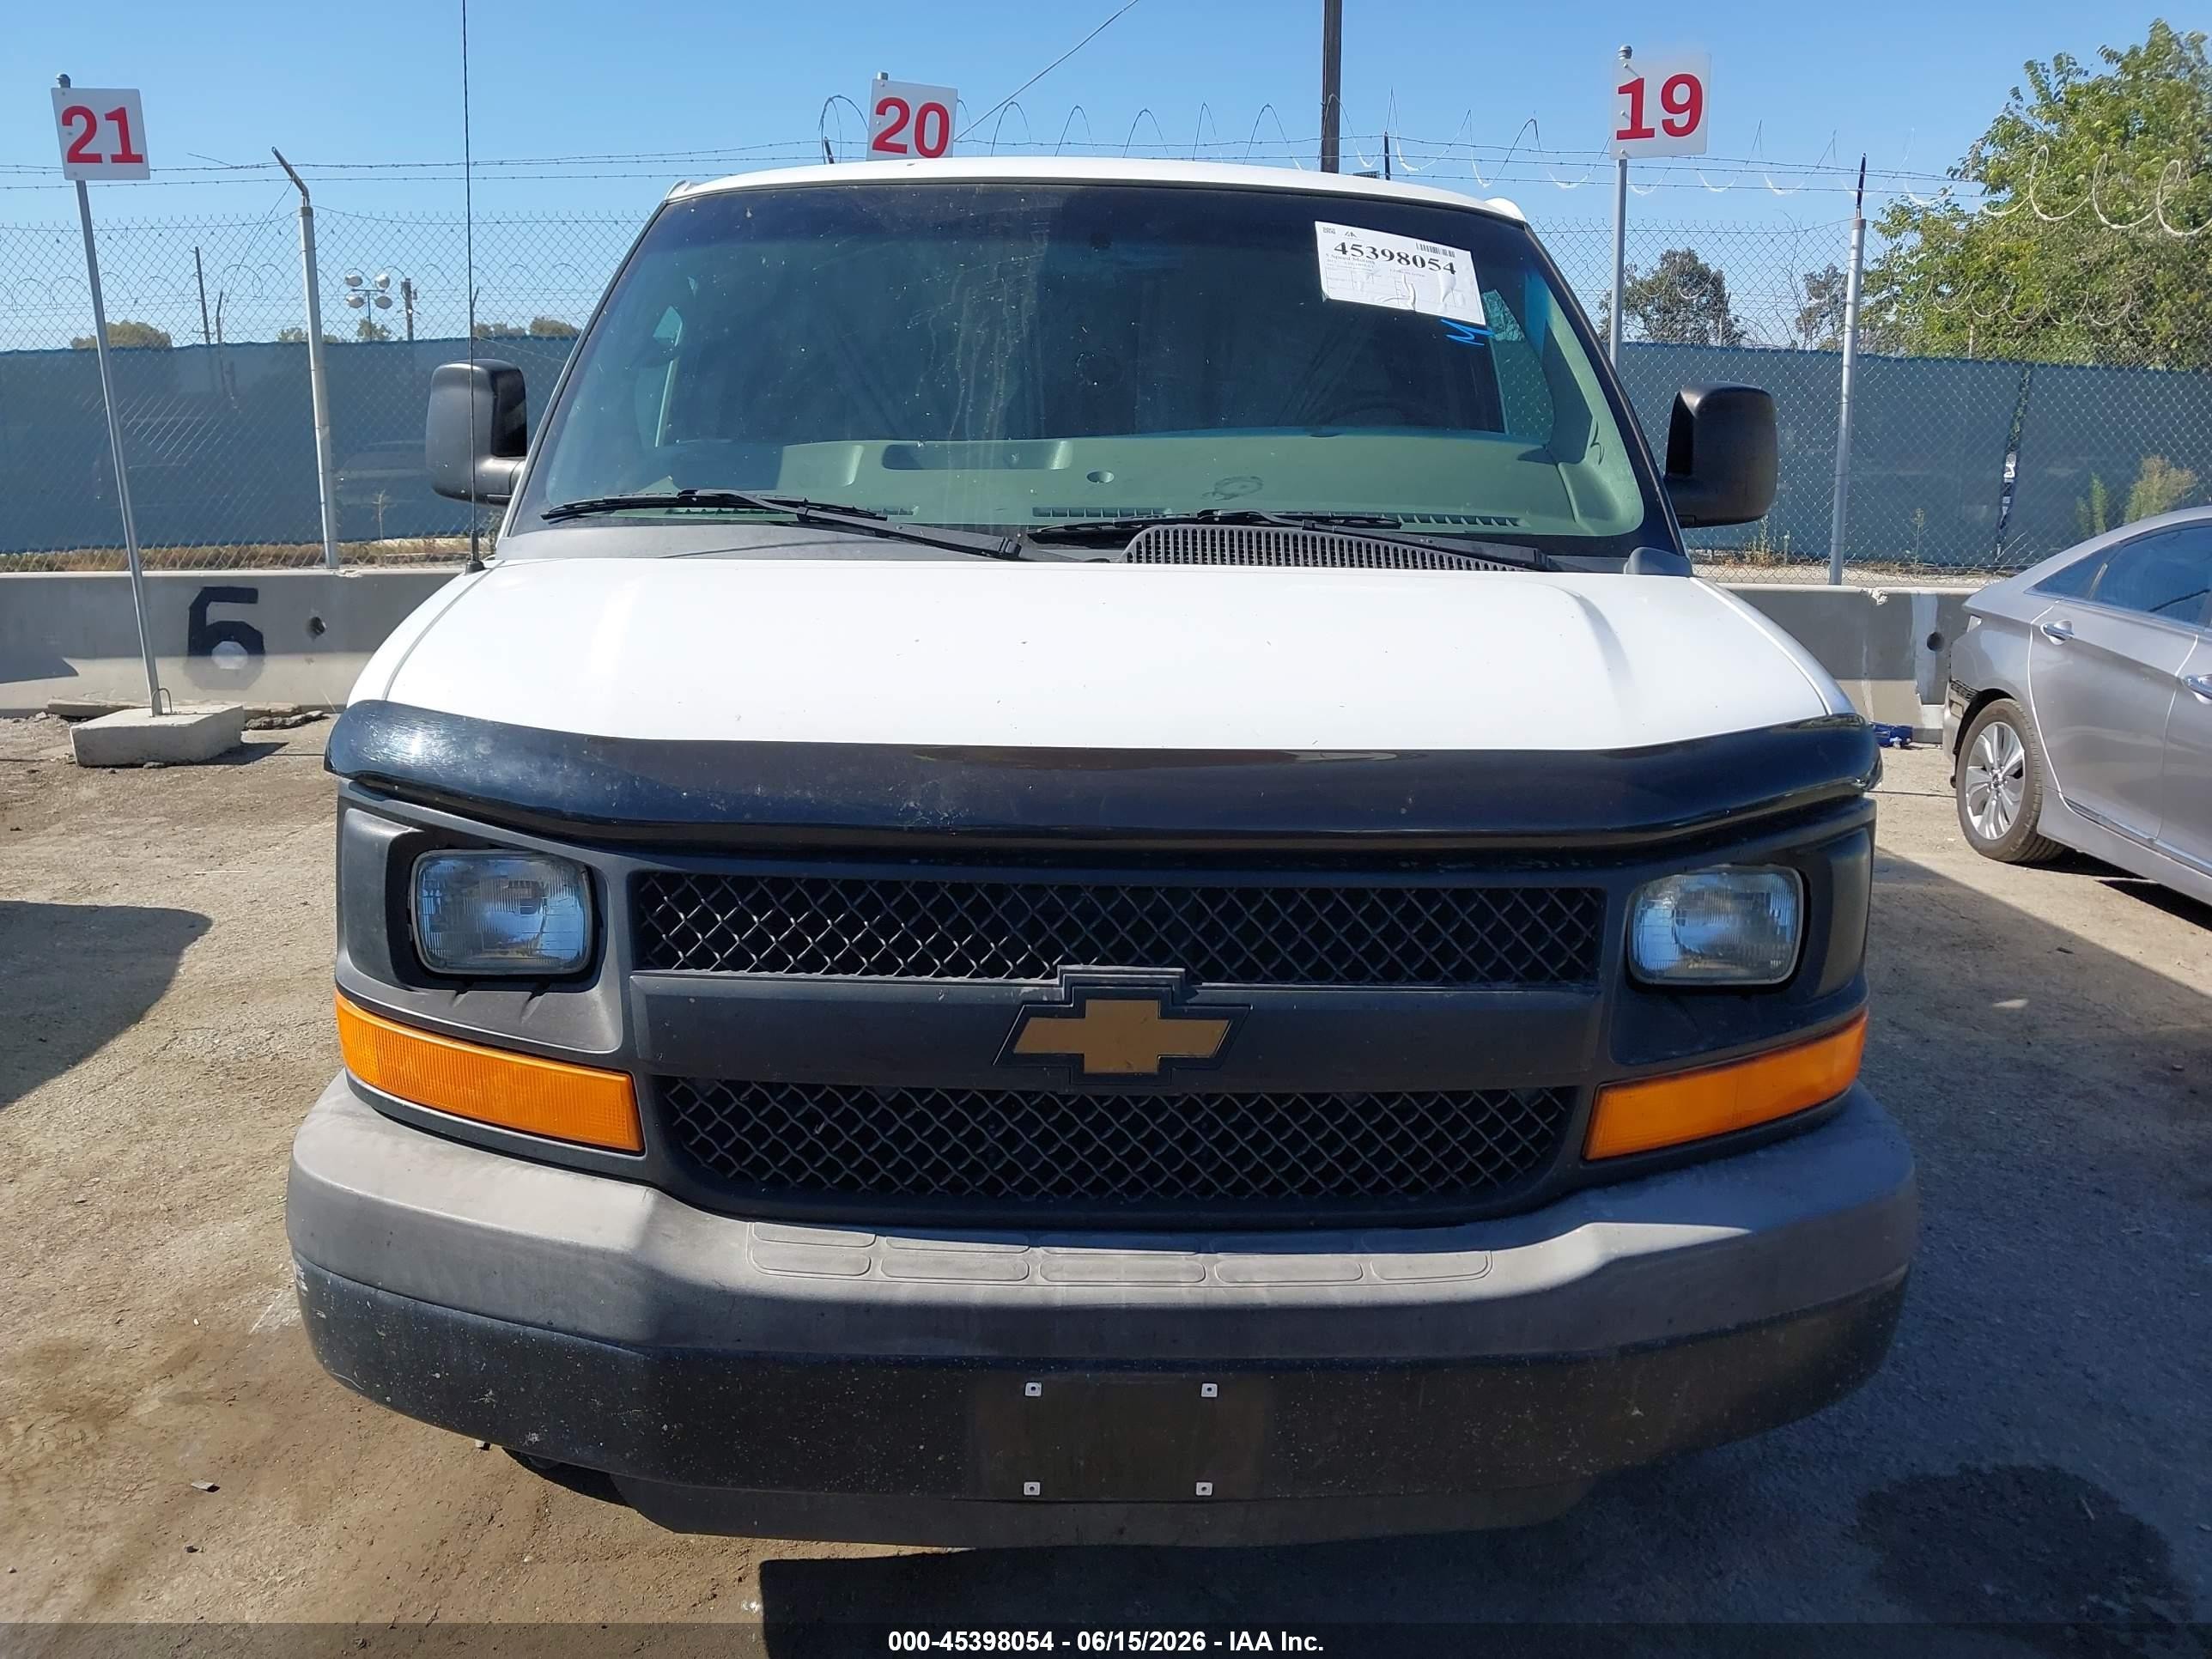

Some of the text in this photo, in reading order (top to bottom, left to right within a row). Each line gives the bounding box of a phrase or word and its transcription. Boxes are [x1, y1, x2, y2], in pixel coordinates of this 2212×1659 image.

[62, 105, 143, 163] 21
[872, 96, 950, 158] 20
[1616, 73, 1703, 140] 19
[1333, 241, 1457, 275] 45398054
[184, 586, 266, 690] 6
